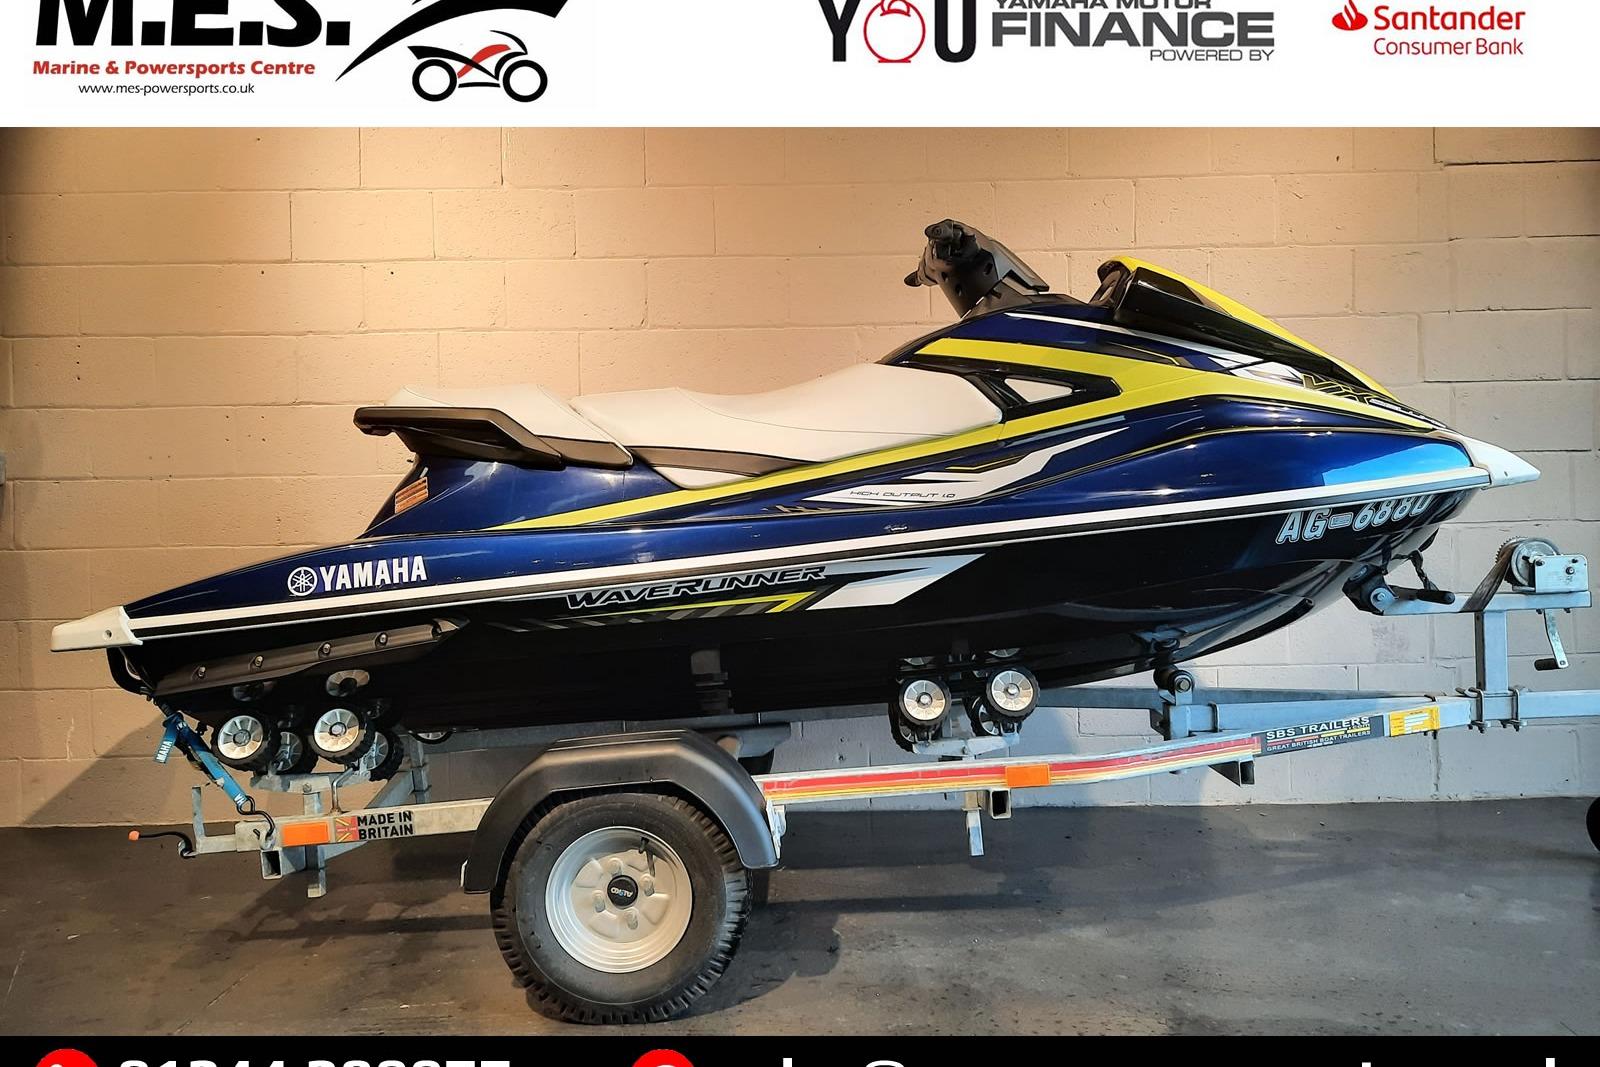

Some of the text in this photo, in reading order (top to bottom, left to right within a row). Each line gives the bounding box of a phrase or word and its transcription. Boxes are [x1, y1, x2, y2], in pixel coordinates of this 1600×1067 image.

[320, 556, 427, 591] YAMAHA
[1266, 717, 1370, 740] SBS TRAILERS
[1267, 743, 1289, 751] GREAT
[1291, 738, 1318, 748] BRITISH
[1320, 735, 1337, 743] BOAT
[1339, 731, 1370, 740] TRAILERS
[357, 811, 413, 826] MADE IN
[358, 824, 414, 840] BRITAIN
